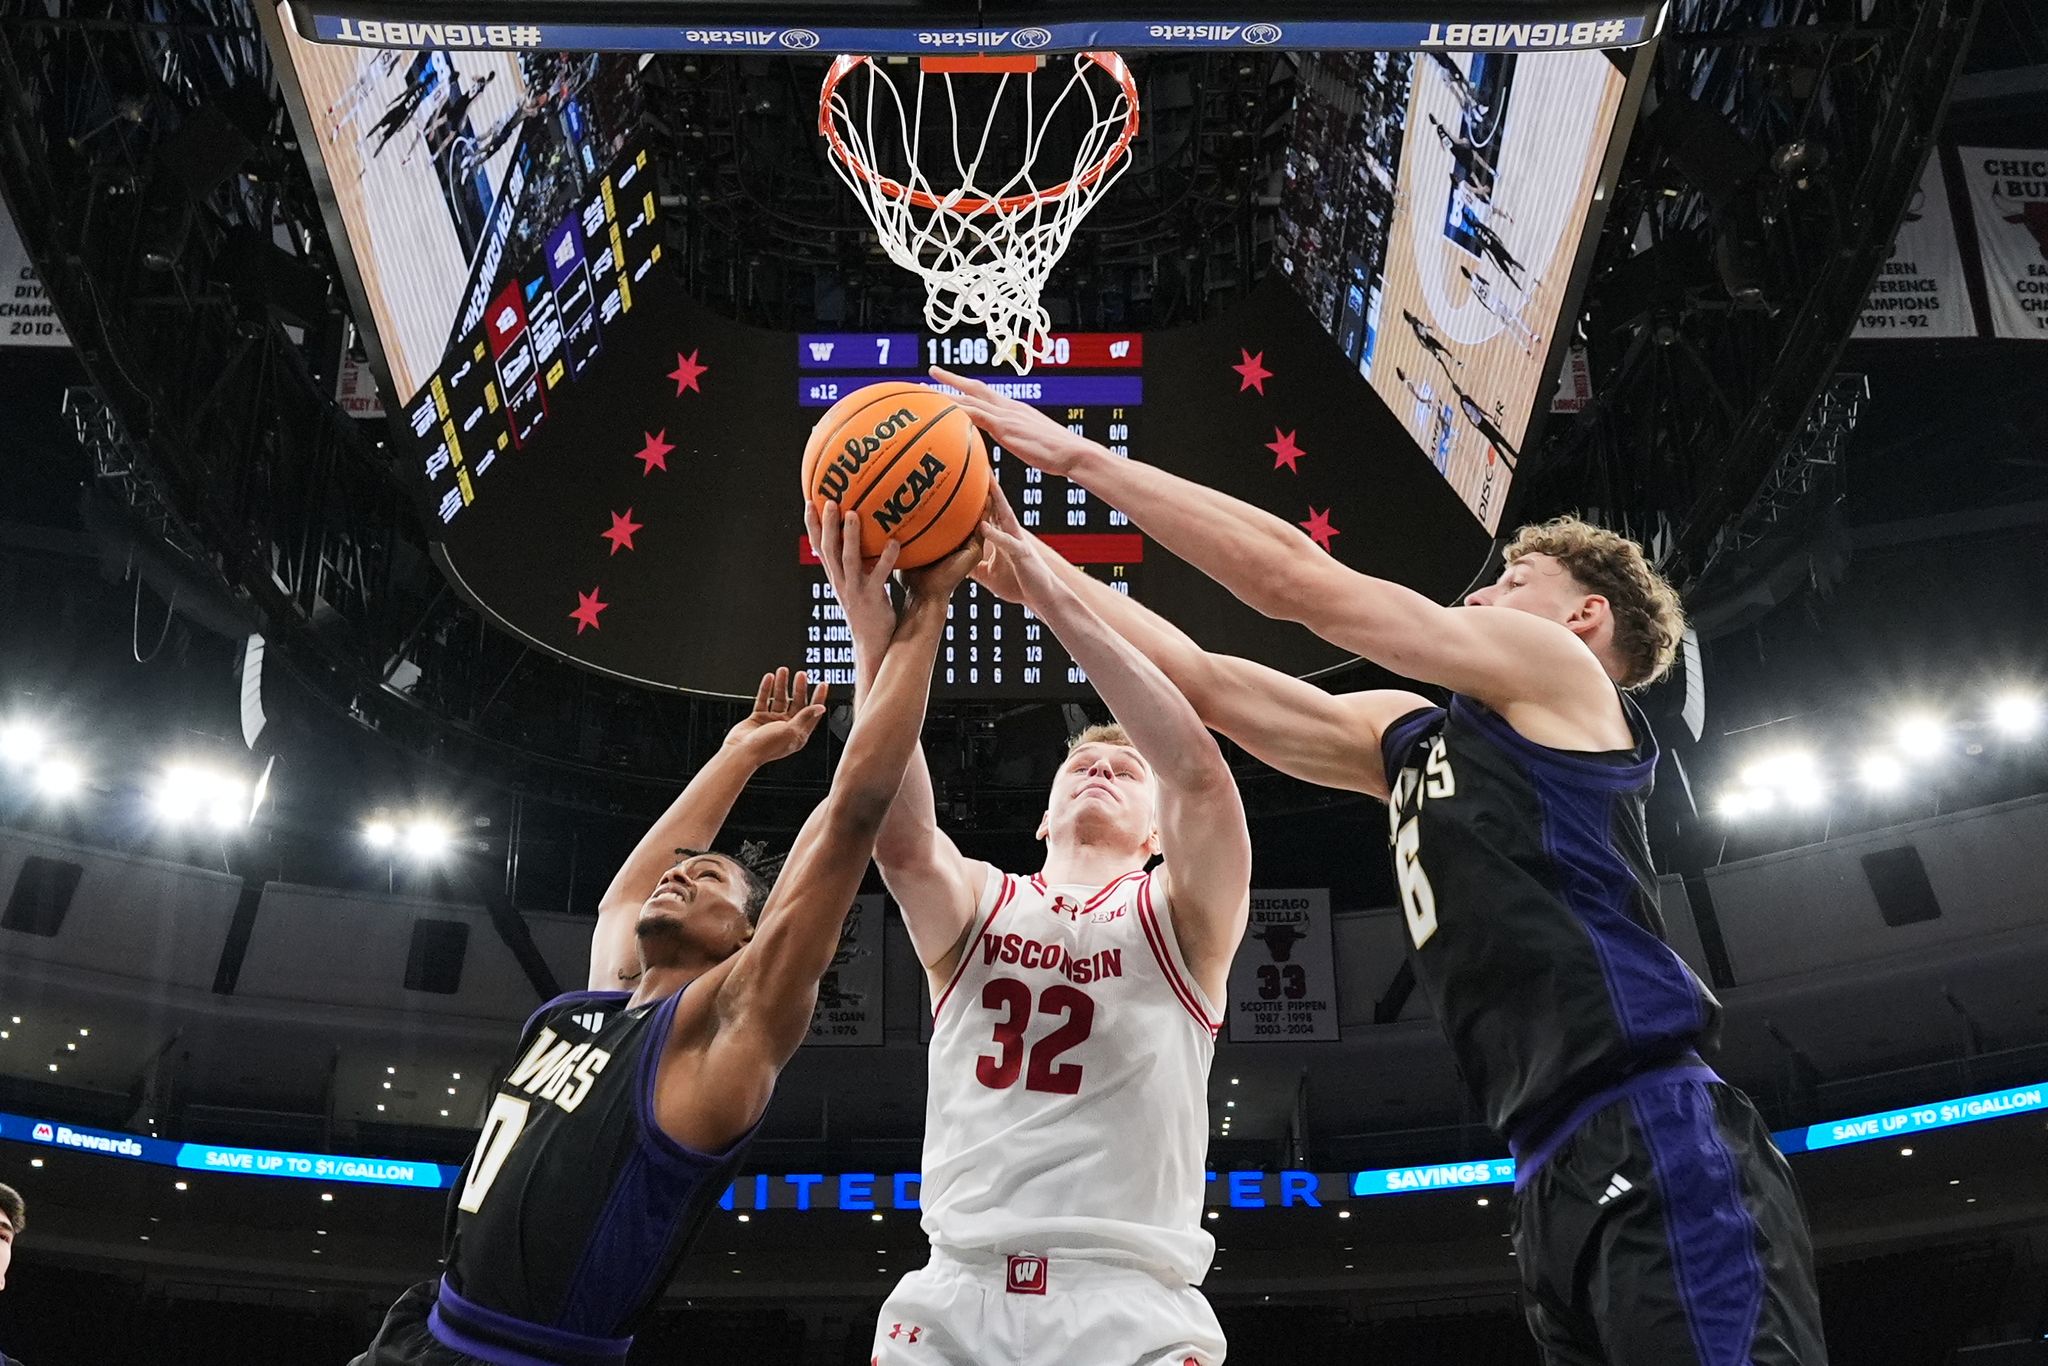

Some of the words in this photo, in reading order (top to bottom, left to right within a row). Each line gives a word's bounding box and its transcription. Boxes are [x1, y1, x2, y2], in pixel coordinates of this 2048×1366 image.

[335, 17, 542, 47] #B1GMBBT
[1419, 20, 1625, 47] #B1GMBBT
[877, 339, 890, 365] 7
[927, 338, 989, 365] 11:06
[810, 383, 838, 400] #12
[1067, 409, 1085, 419] 3PT
[1113, 409, 1124, 420] FT
[1109, 424, 1129, 441] 0/0
[818, 408, 920, 504] Wilson
[1025, 467, 1042, 483] 1/3
[872, 453, 947, 533] NCAA
[1023, 488, 1042, 505] 0/0
[1067, 488, 1087, 505] 0/0
[1023, 510, 1041, 526] 0/1
[1067, 510, 1087, 526] 0/0
[1113, 566, 1124, 577] FT
[970, 583, 978, 598] 3
[812, 605, 821, 620] 4
[970, 604, 978, 620] 0
[994, 604, 1002, 620] 0
[808, 626, 821, 641] 13
[946, 625, 954, 641] 0
[970, 625, 978, 641] 3
[994, 625, 1002, 641] 0
[1026, 625, 1041, 641] 1/1
[806, 648, 821, 663] 25
[946, 646, 954, 662] 0
[970, 646, 978, 662] 3
[994, 646, 1002, 662] 2
[1026, 646, 1043, 662] 1/3
[946, 668, 954, 684] 0
[970, 668, 978, 684] 0
[994, 668, 1002, 684] 6
[1024, 668, 1041, 684] 0/1
[1256, 912, 1302, 922] BULLS
[983, 932, 1123, 985] WSCONSIN
[1257, 964, 1307, 1000] 33
[1240, 1002, 1283, 1012] SCOTTIE
[1287, 1001, 1327, 1011] PIPPEN
[976, 977, 1095, 1095] 32
[1833, 1121, 1879, 1140] SAVE
[1882, 1115, 1908, 1131] UP
[1914, 1109, 1937, 1125] TO
[1940, 1090, 2042, 1122] $1/GALLON
[56, 1127, 142, 1157] Rewards
[458, 1091, 531, 1215] 0
[205, 1151, 253, 1169] SAVE
[257, 1154, 282, 1171] UP
[288, 1156, 309, 1174] TO
[314, 1157, 414, 1182] $1/GALLON
[1386, 1164, 1491, 1190] SAVINGS
[1495, 1165, 1511, 1176] TO
